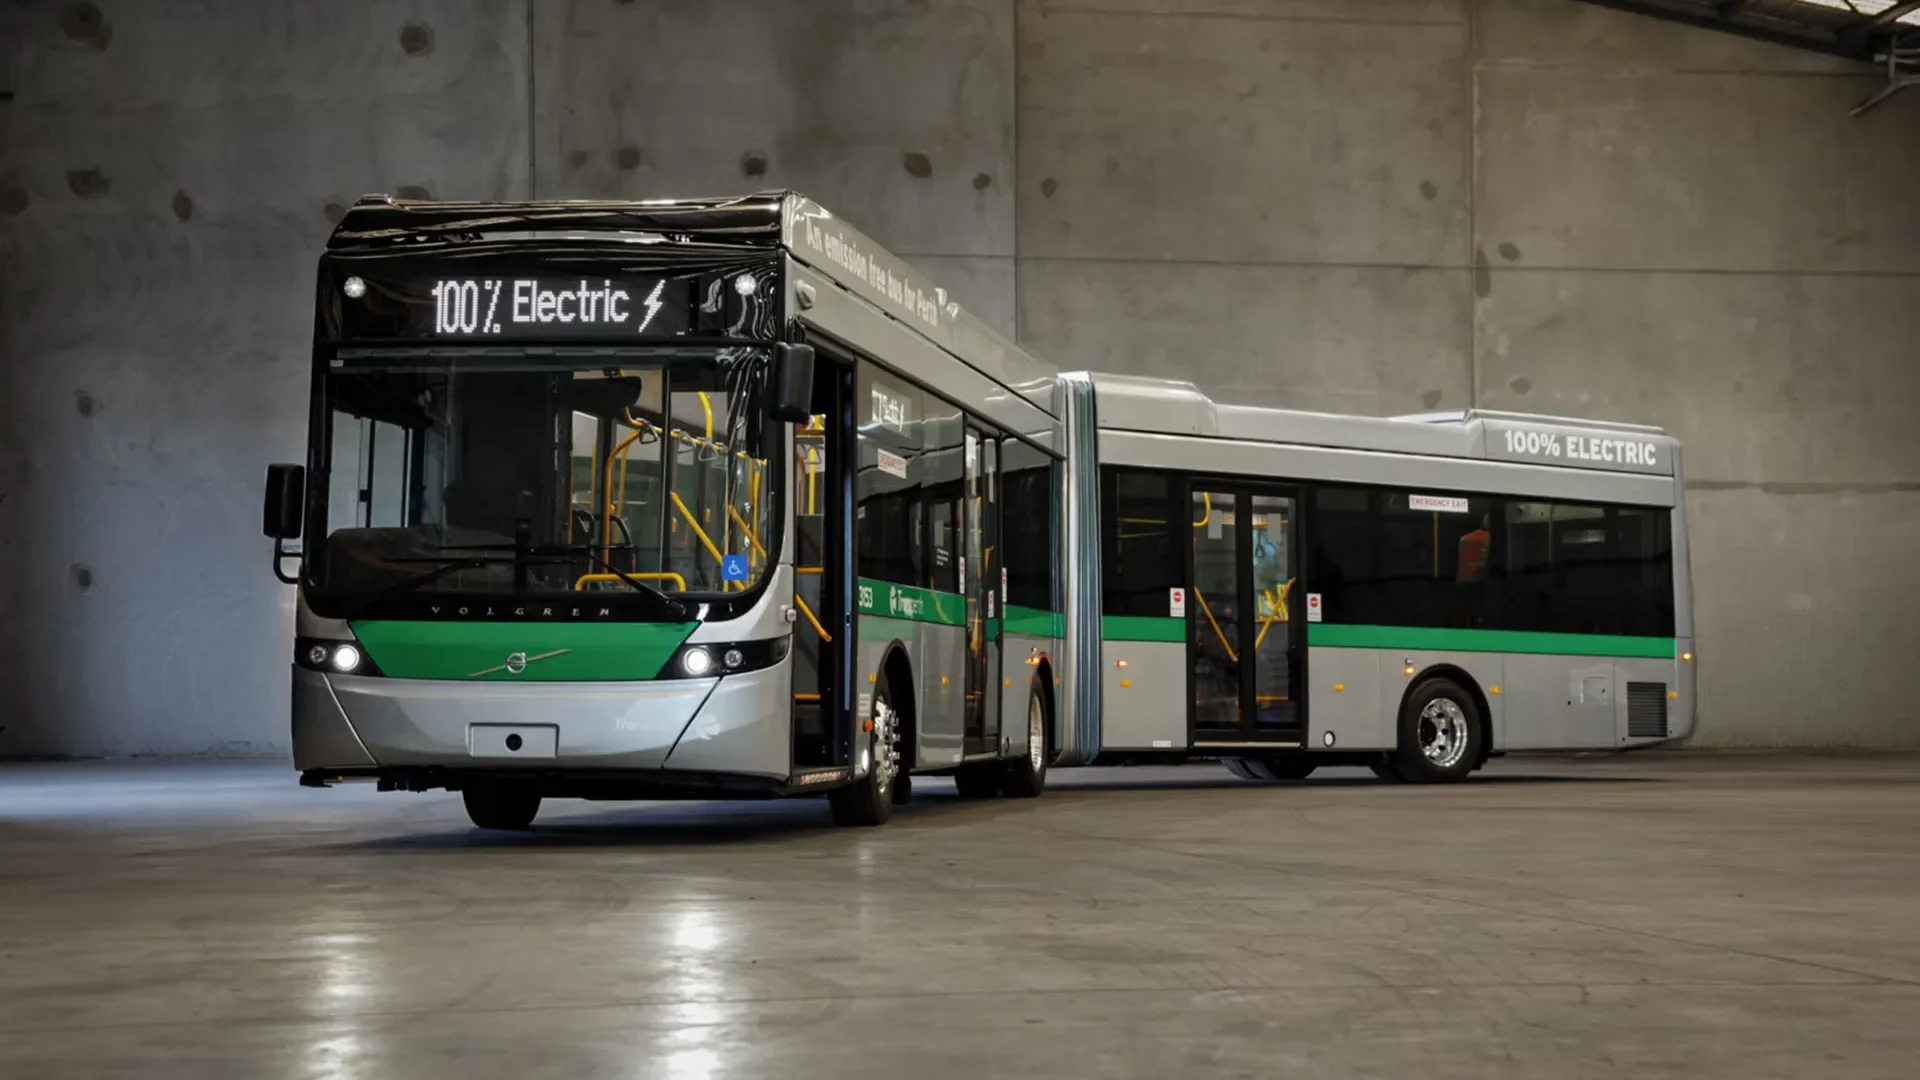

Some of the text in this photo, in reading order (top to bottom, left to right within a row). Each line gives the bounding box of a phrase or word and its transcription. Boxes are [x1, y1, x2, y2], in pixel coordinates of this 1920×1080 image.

[806, 214, 938, 327] An emission free bus for Perth
[432, 279, 629, 333] 100% Electric
[1505, 429, 1657, 466] 100% ELECTRIC
[431, 606, 609, 616] VOLGREN
